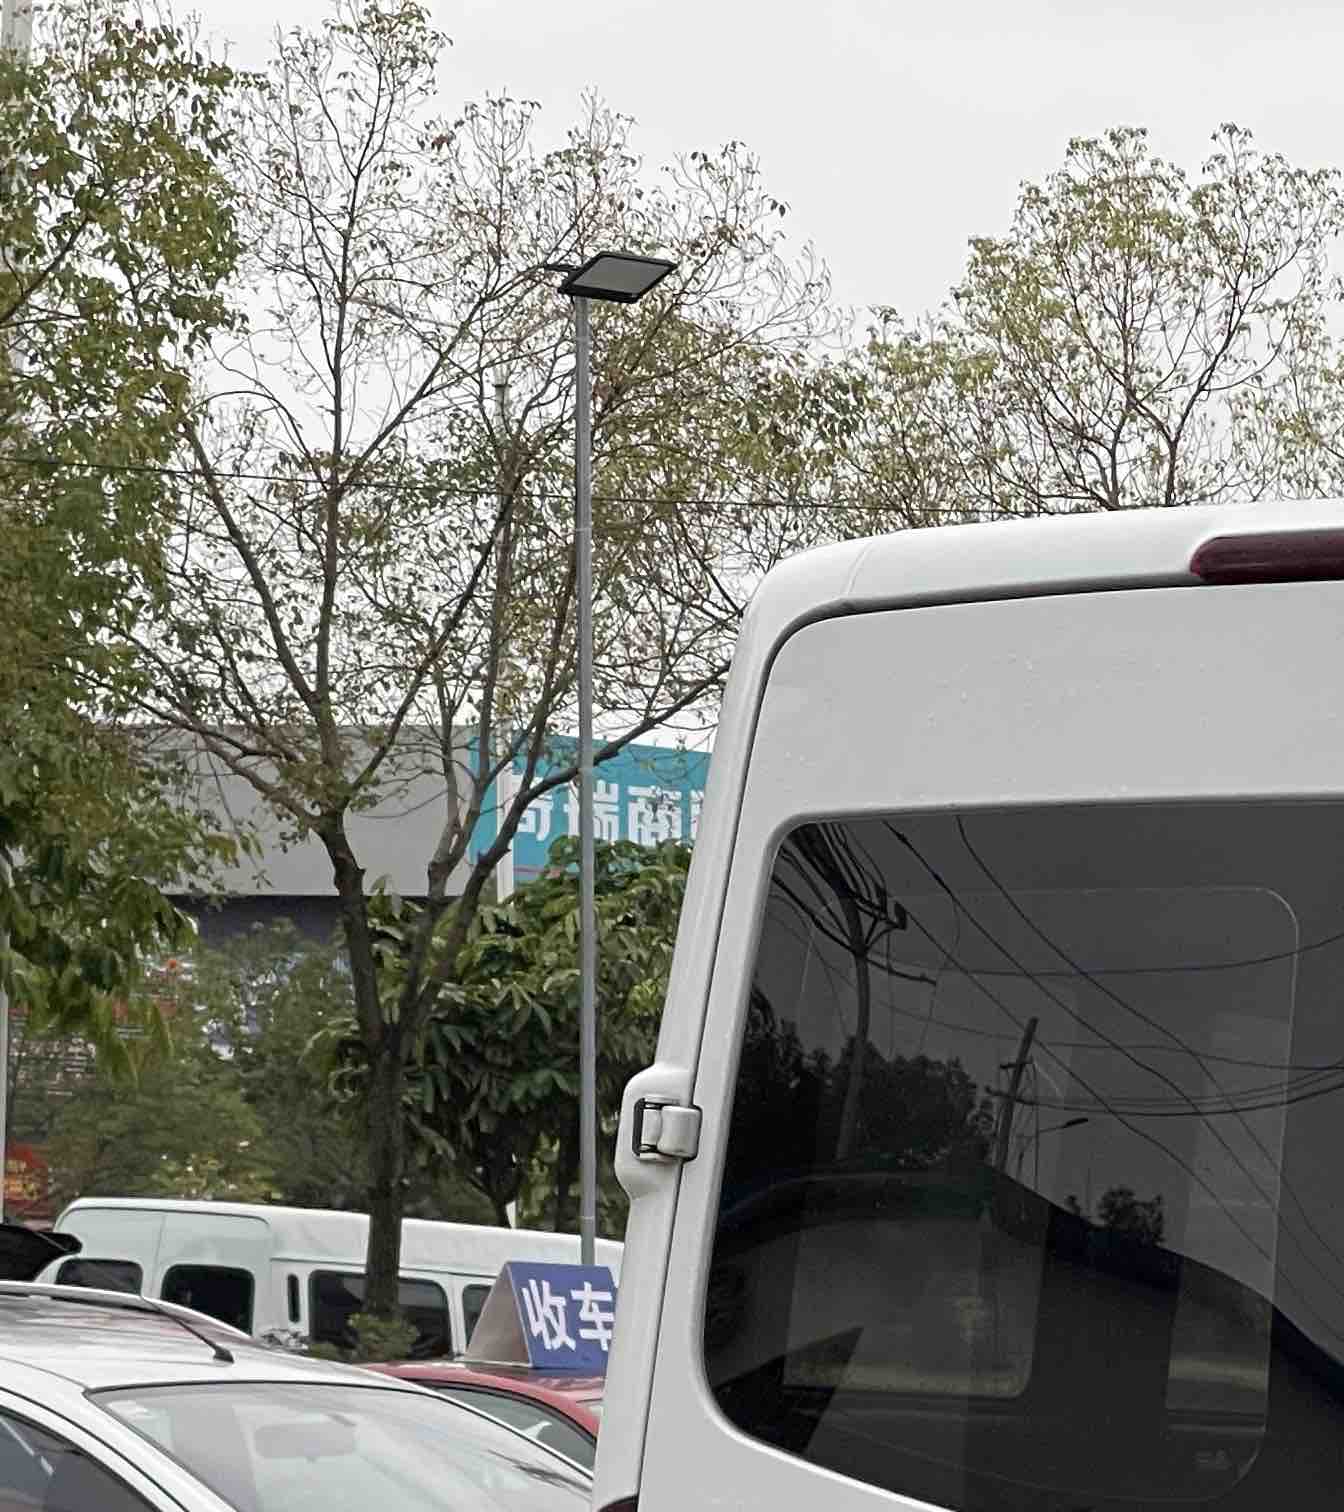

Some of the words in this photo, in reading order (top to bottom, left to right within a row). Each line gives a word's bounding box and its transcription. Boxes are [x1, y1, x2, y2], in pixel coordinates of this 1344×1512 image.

[512, 774, 705, 847] 奇瑞商
[521, 1279, 614, 1351] 收车
